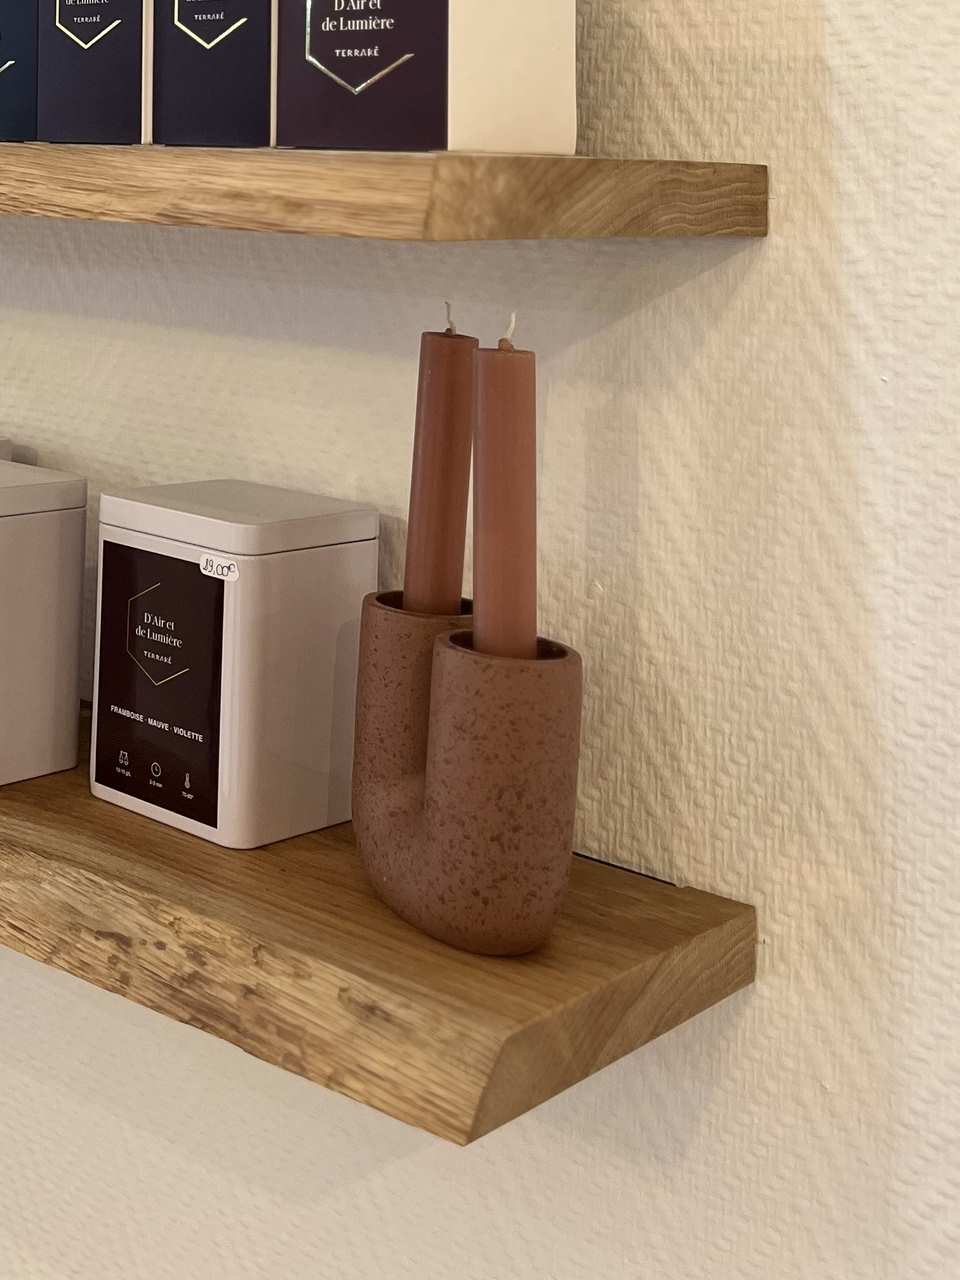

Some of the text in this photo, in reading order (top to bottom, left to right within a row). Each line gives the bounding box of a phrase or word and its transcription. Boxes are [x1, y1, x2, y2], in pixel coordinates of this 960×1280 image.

[321, 15, 395, 32] de Lumière
[334, 45, 380, 57] TERRAKÉ
[144, 612, 175, 631] D'Air et
[135, 625, 183, 648] de Lumière
[110, 705, 204, 742] FRAMBOISE MAUVE VIOLETTE
